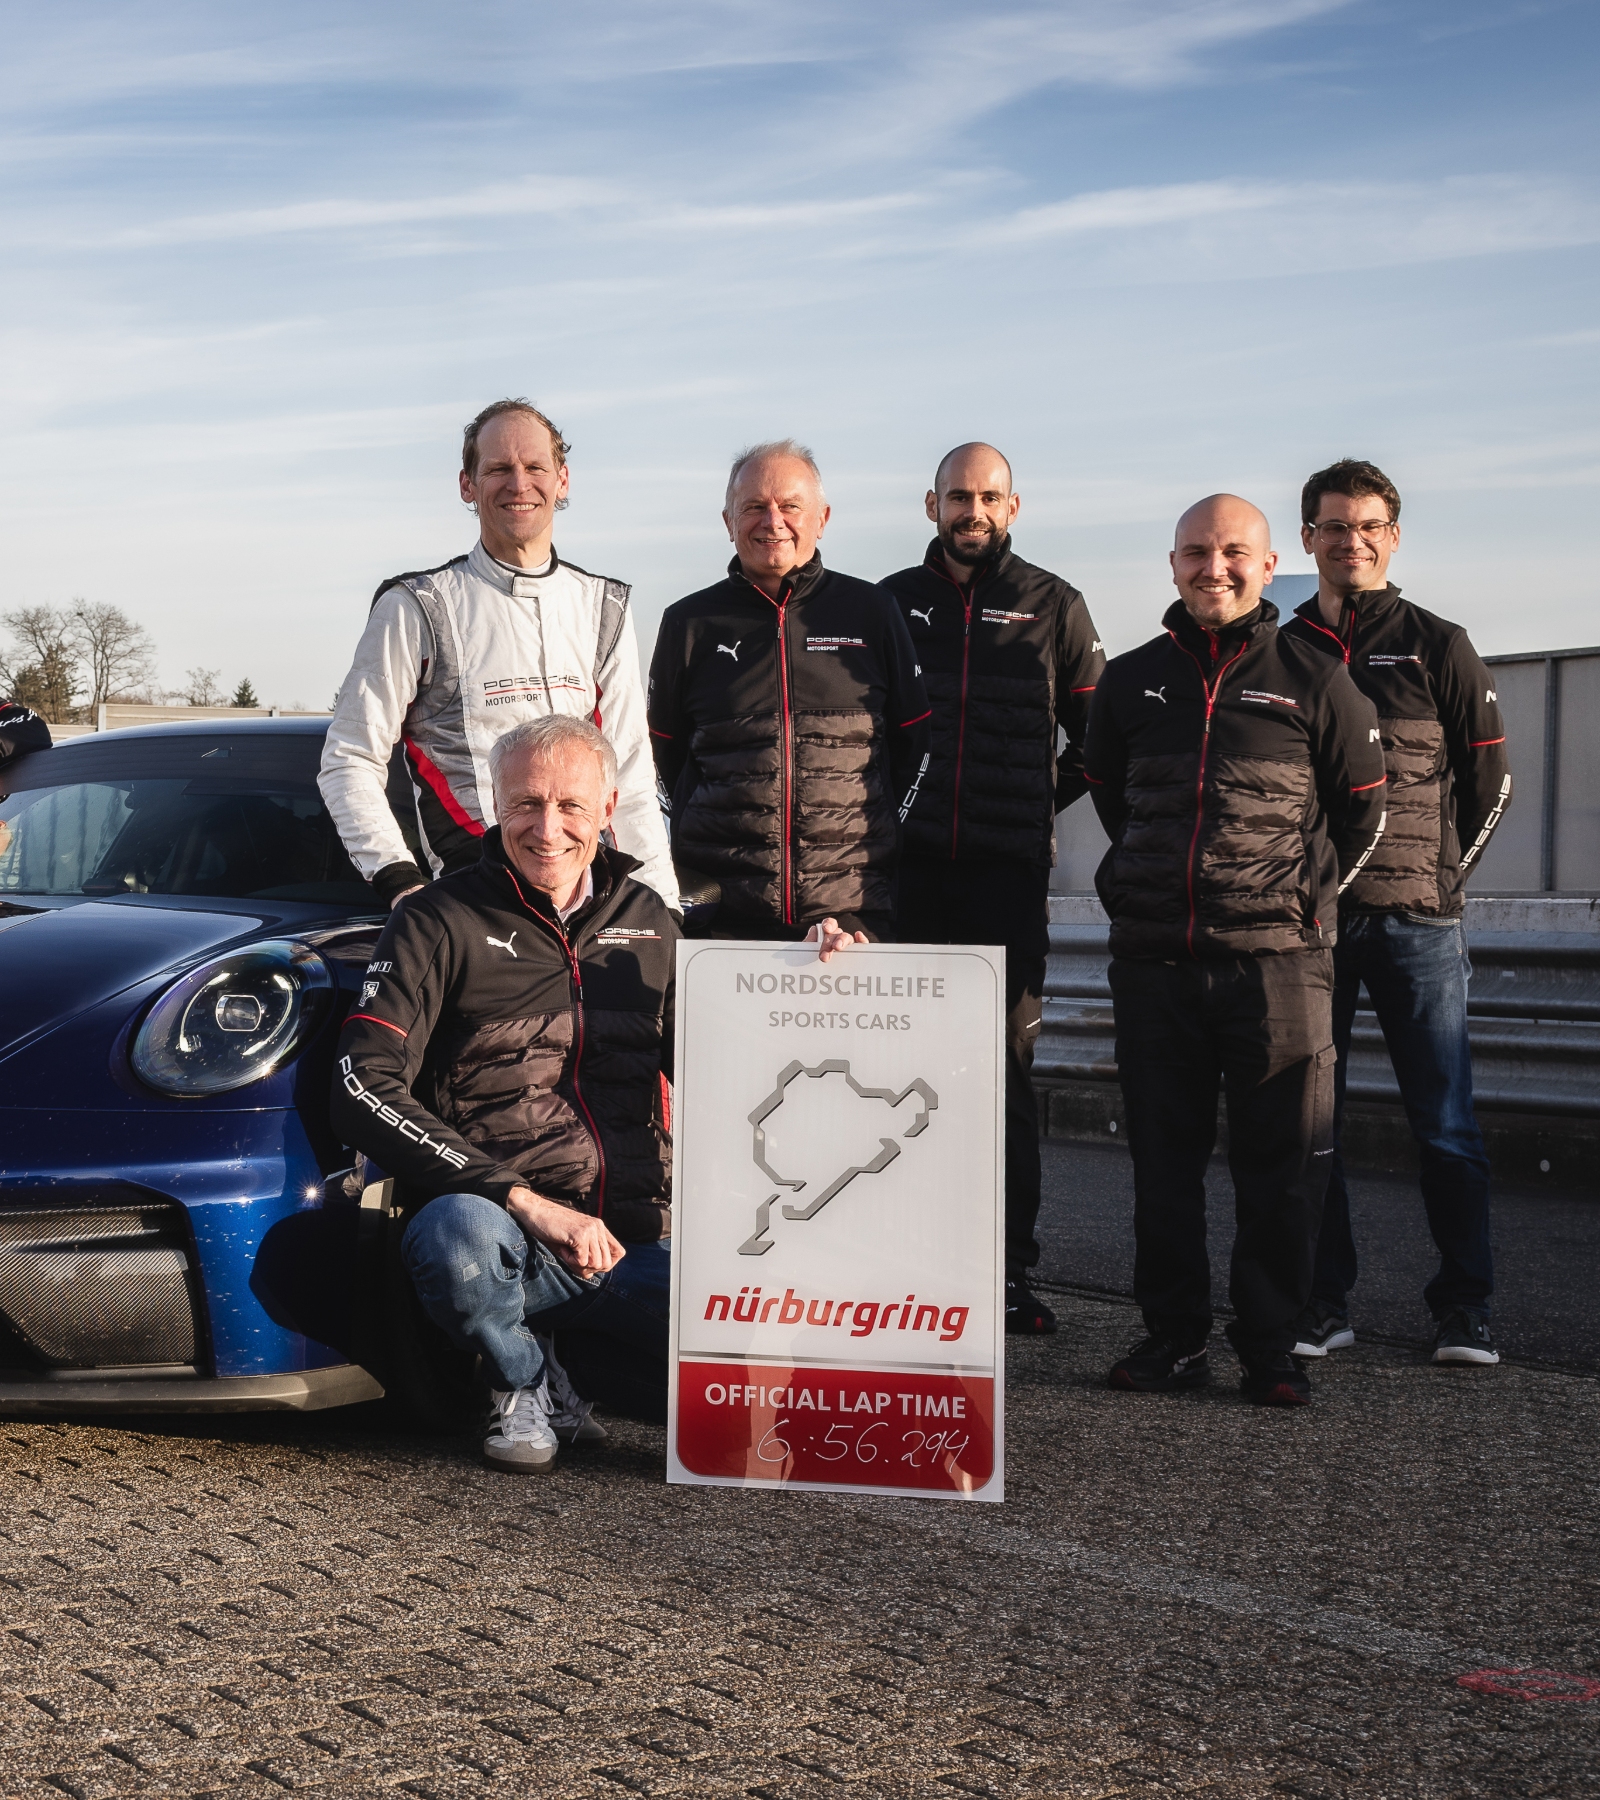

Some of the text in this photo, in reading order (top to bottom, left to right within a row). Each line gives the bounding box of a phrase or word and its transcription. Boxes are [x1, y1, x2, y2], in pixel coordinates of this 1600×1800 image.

[982, 609, 1035, 619] PORSCHE
[483, 674, 581, 691] PORSCHE
[485, 693, 542, 707] MOTORSPORT
[1242, 689, 1296, 705] PORSCHE
[736, 973, 945, 998] NORDSCHLEIFE
[768, 1011, 911, 1031] SPORTS CARS
[339, 1055, 469, 1169] PORSCHE
[703, 1287, 970, 1341] nürburgring
[705, 1383, 966, 1419] OFFICIAL LAP TIME
